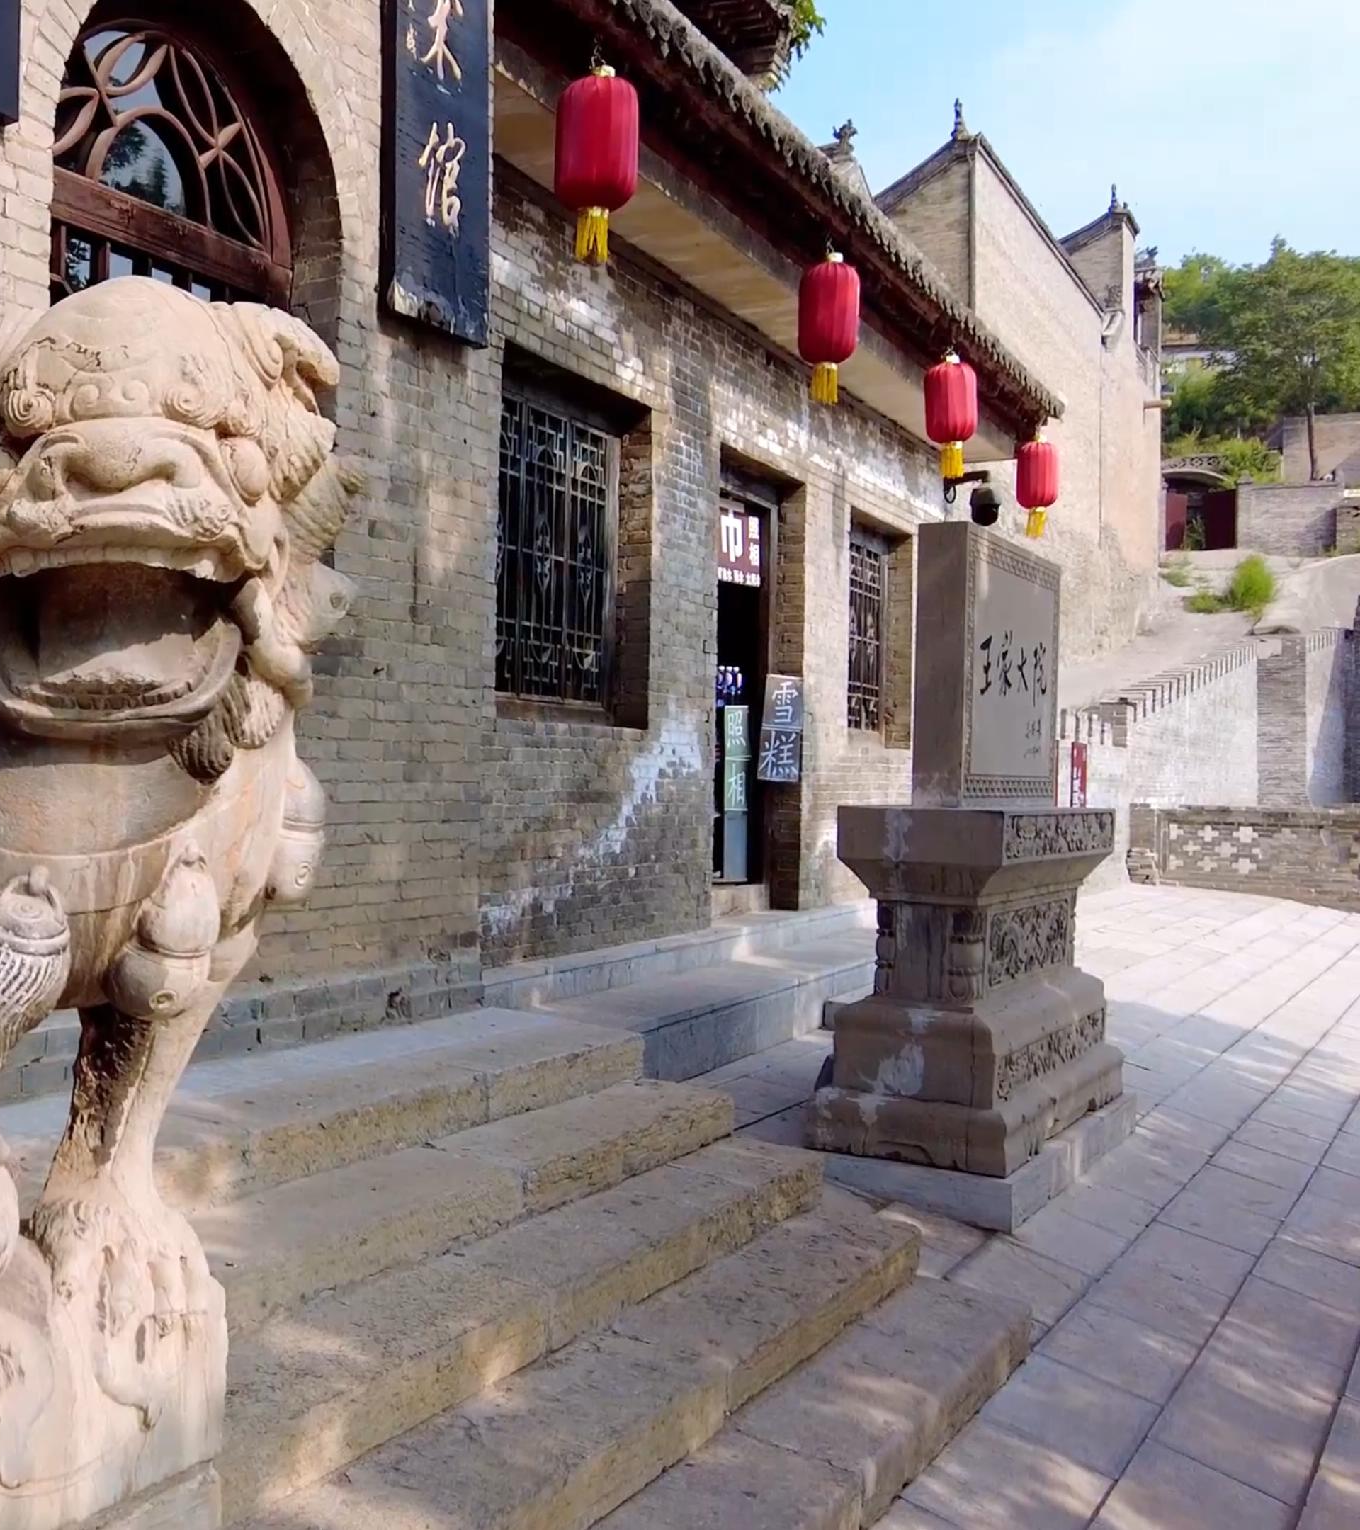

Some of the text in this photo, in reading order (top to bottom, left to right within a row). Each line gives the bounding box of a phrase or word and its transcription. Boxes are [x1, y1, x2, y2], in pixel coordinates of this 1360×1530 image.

[979, 630, 1047, 707] 王家大院
[727, 710, 746, 807] 照相
[759, 681, 799, 778] 雪糕
